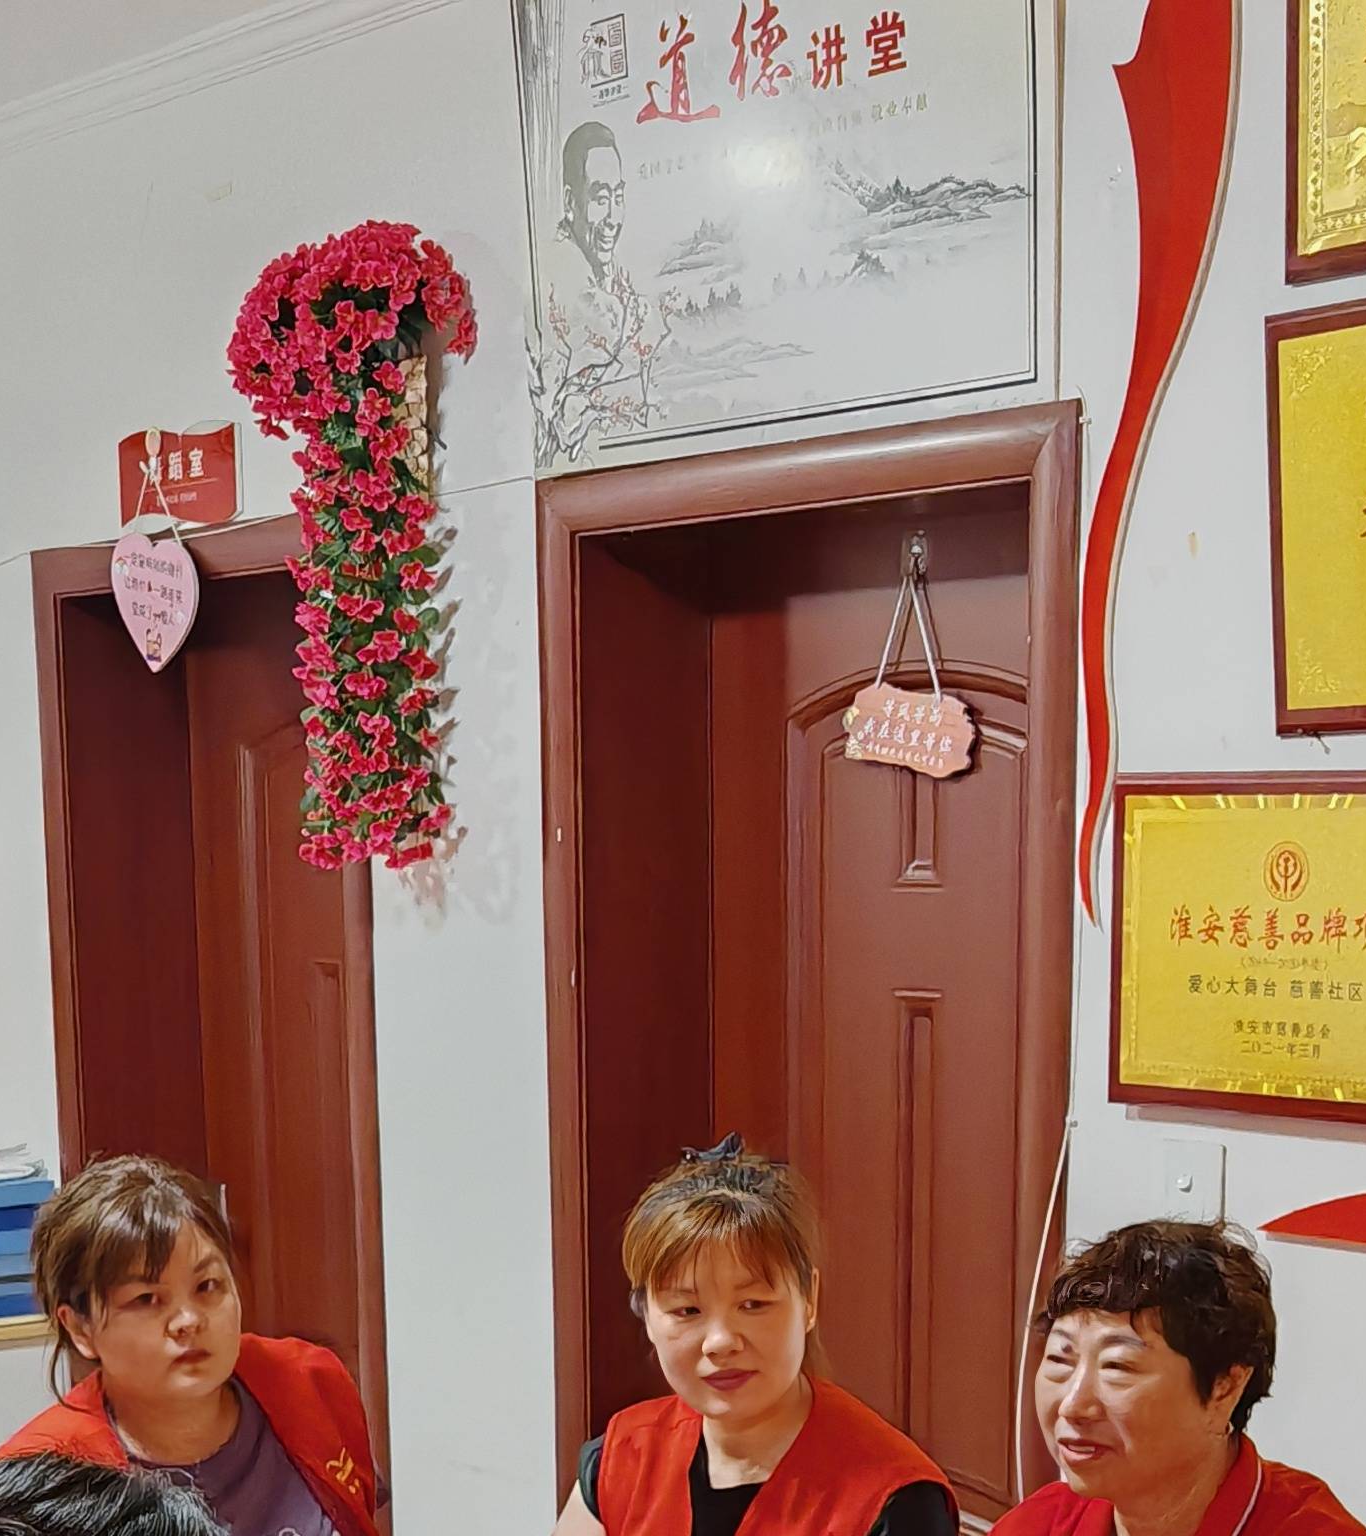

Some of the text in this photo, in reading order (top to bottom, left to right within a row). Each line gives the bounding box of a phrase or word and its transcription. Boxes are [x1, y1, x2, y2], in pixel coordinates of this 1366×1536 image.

[636, 0, 907, 124] 道德讲堂
[1187, 974, 1278, 999] 爱心大舞台
